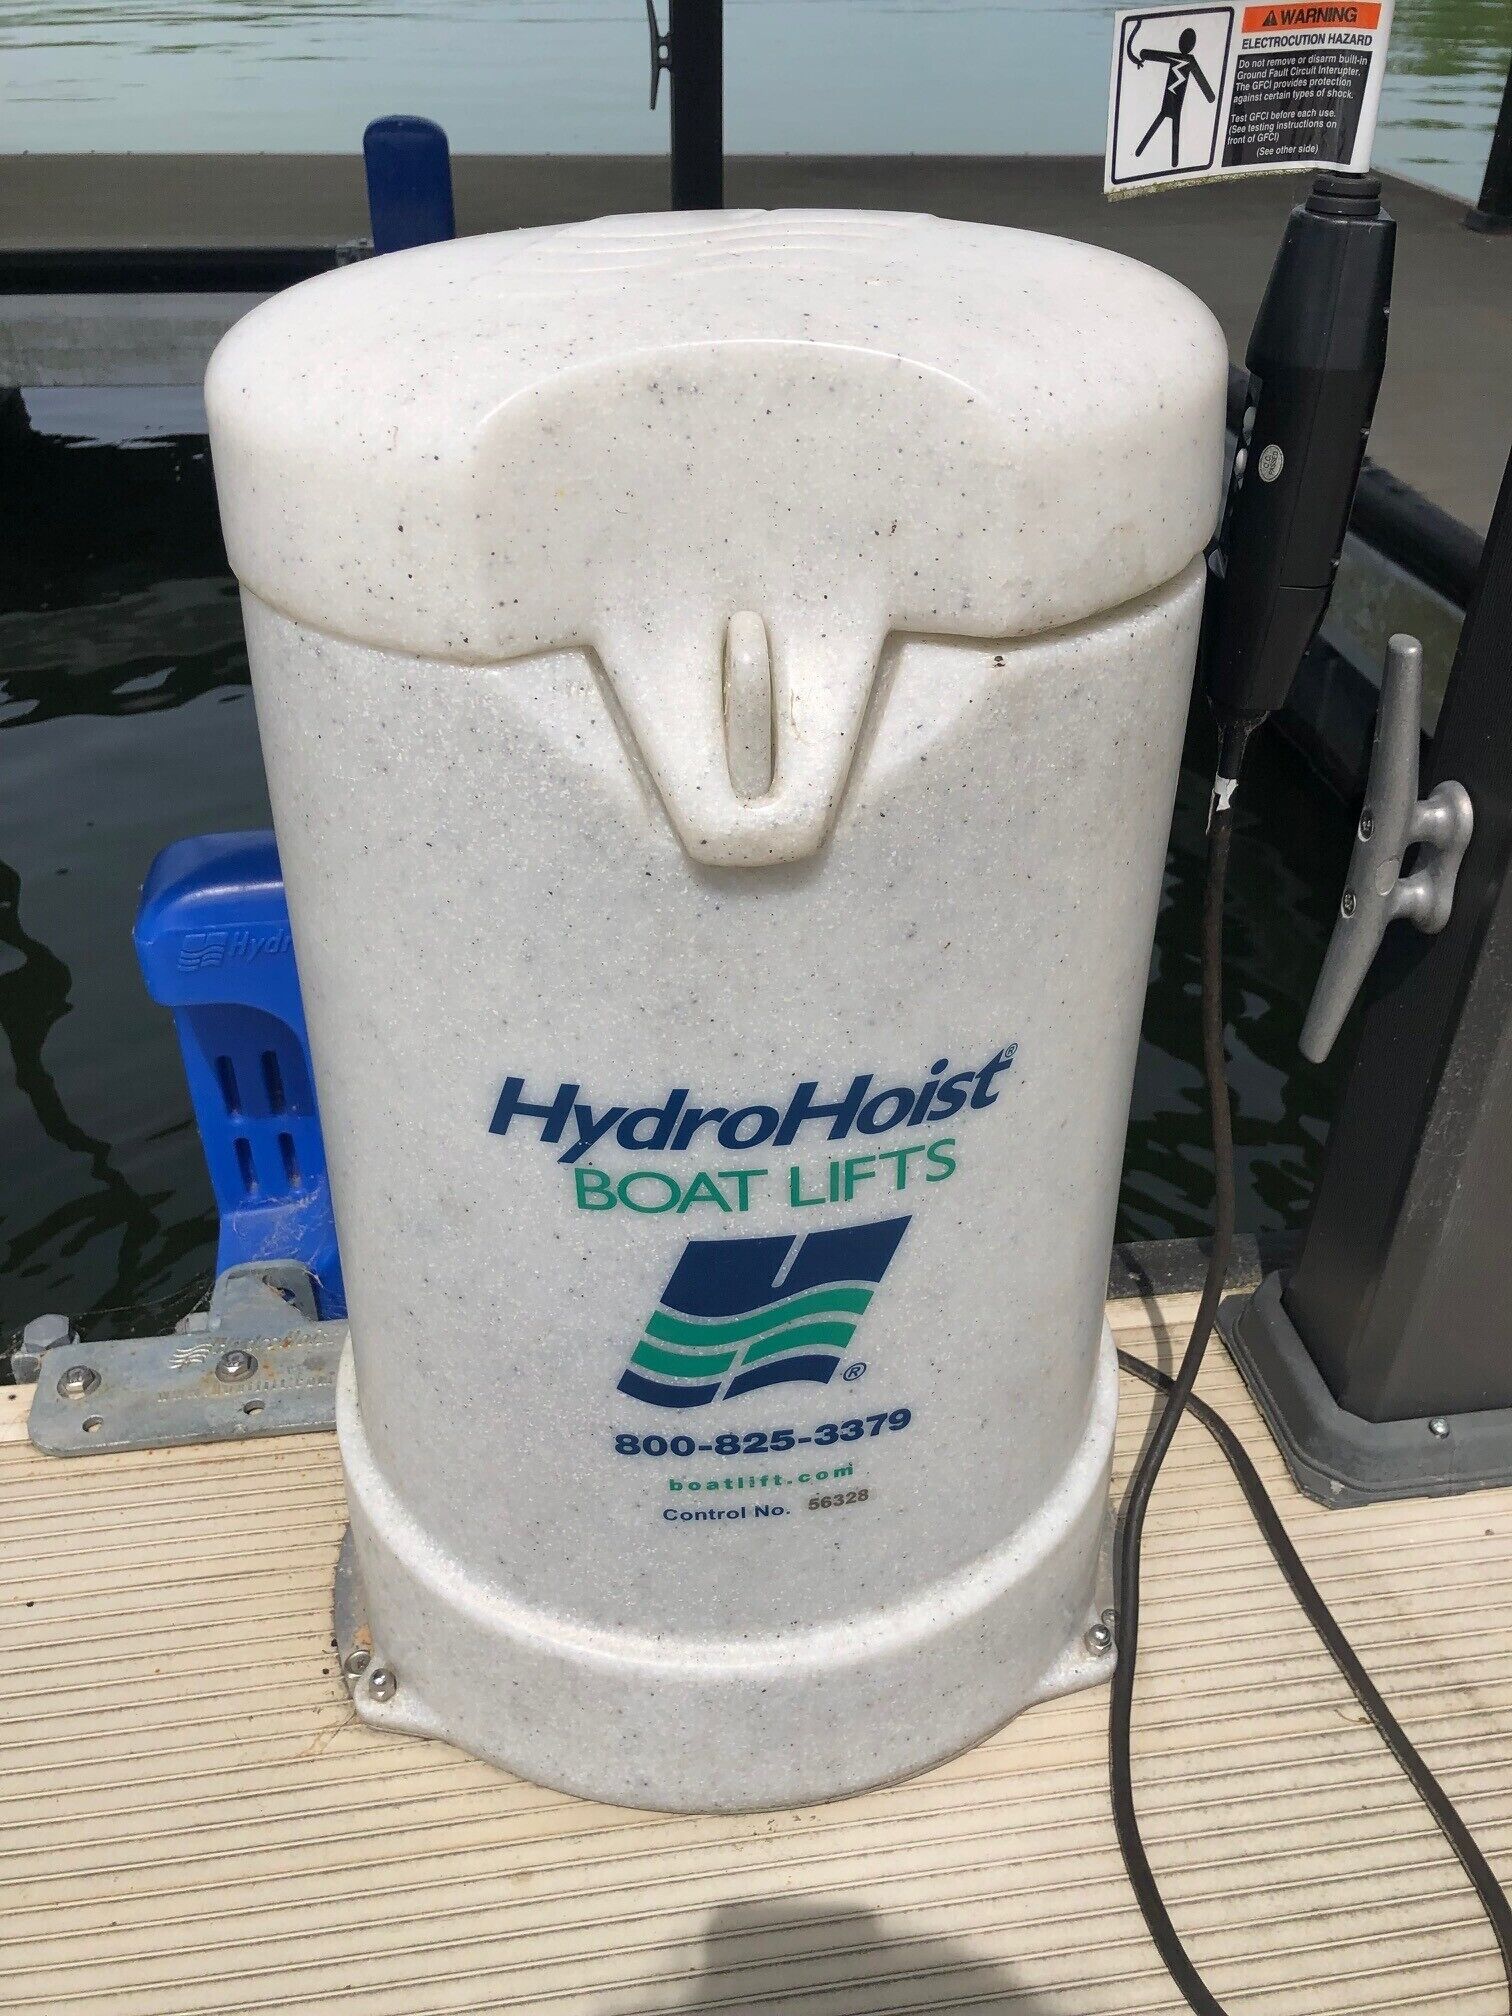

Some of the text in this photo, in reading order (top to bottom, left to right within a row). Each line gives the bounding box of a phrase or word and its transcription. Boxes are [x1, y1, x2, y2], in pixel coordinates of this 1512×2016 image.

[1281, 7, 1357, 25] WARNING
[1242, 33, 1372, 49] ELECTROCUTION HAZARD
[1239, 54, 1368, 69] Do not remove or disarm built-in
[1237, 71, 1267, 80] Ground
[1269, 68, 1288, 78] Fault
[1290, 66, 1317, 76] Circuit
[1236, 77, 1352, 91] The GFCI provides protection
[1233, 88, 1354, 105] against certain types of shock.
[1230, 109, 1336, 123] Test GFCI before each use.
[1228, 124, 1247, 135] (See
[1248, 122, 1275, 132] testing
[1276, 119, 1324, 130] instructions
[1227, 136, 1246, 146] front
[1247, 134, 1256, 143] of
[1256, 144, 1319, 158] (See other side)
[574, 1138, 957, 1214] BOAT LIFTS
[614, 1408, 912, 1457] 800-825-3379
[669, 1463, 854, 1492] boatlift.com
[662, 1489, 869, 1521] Control No. 56328
